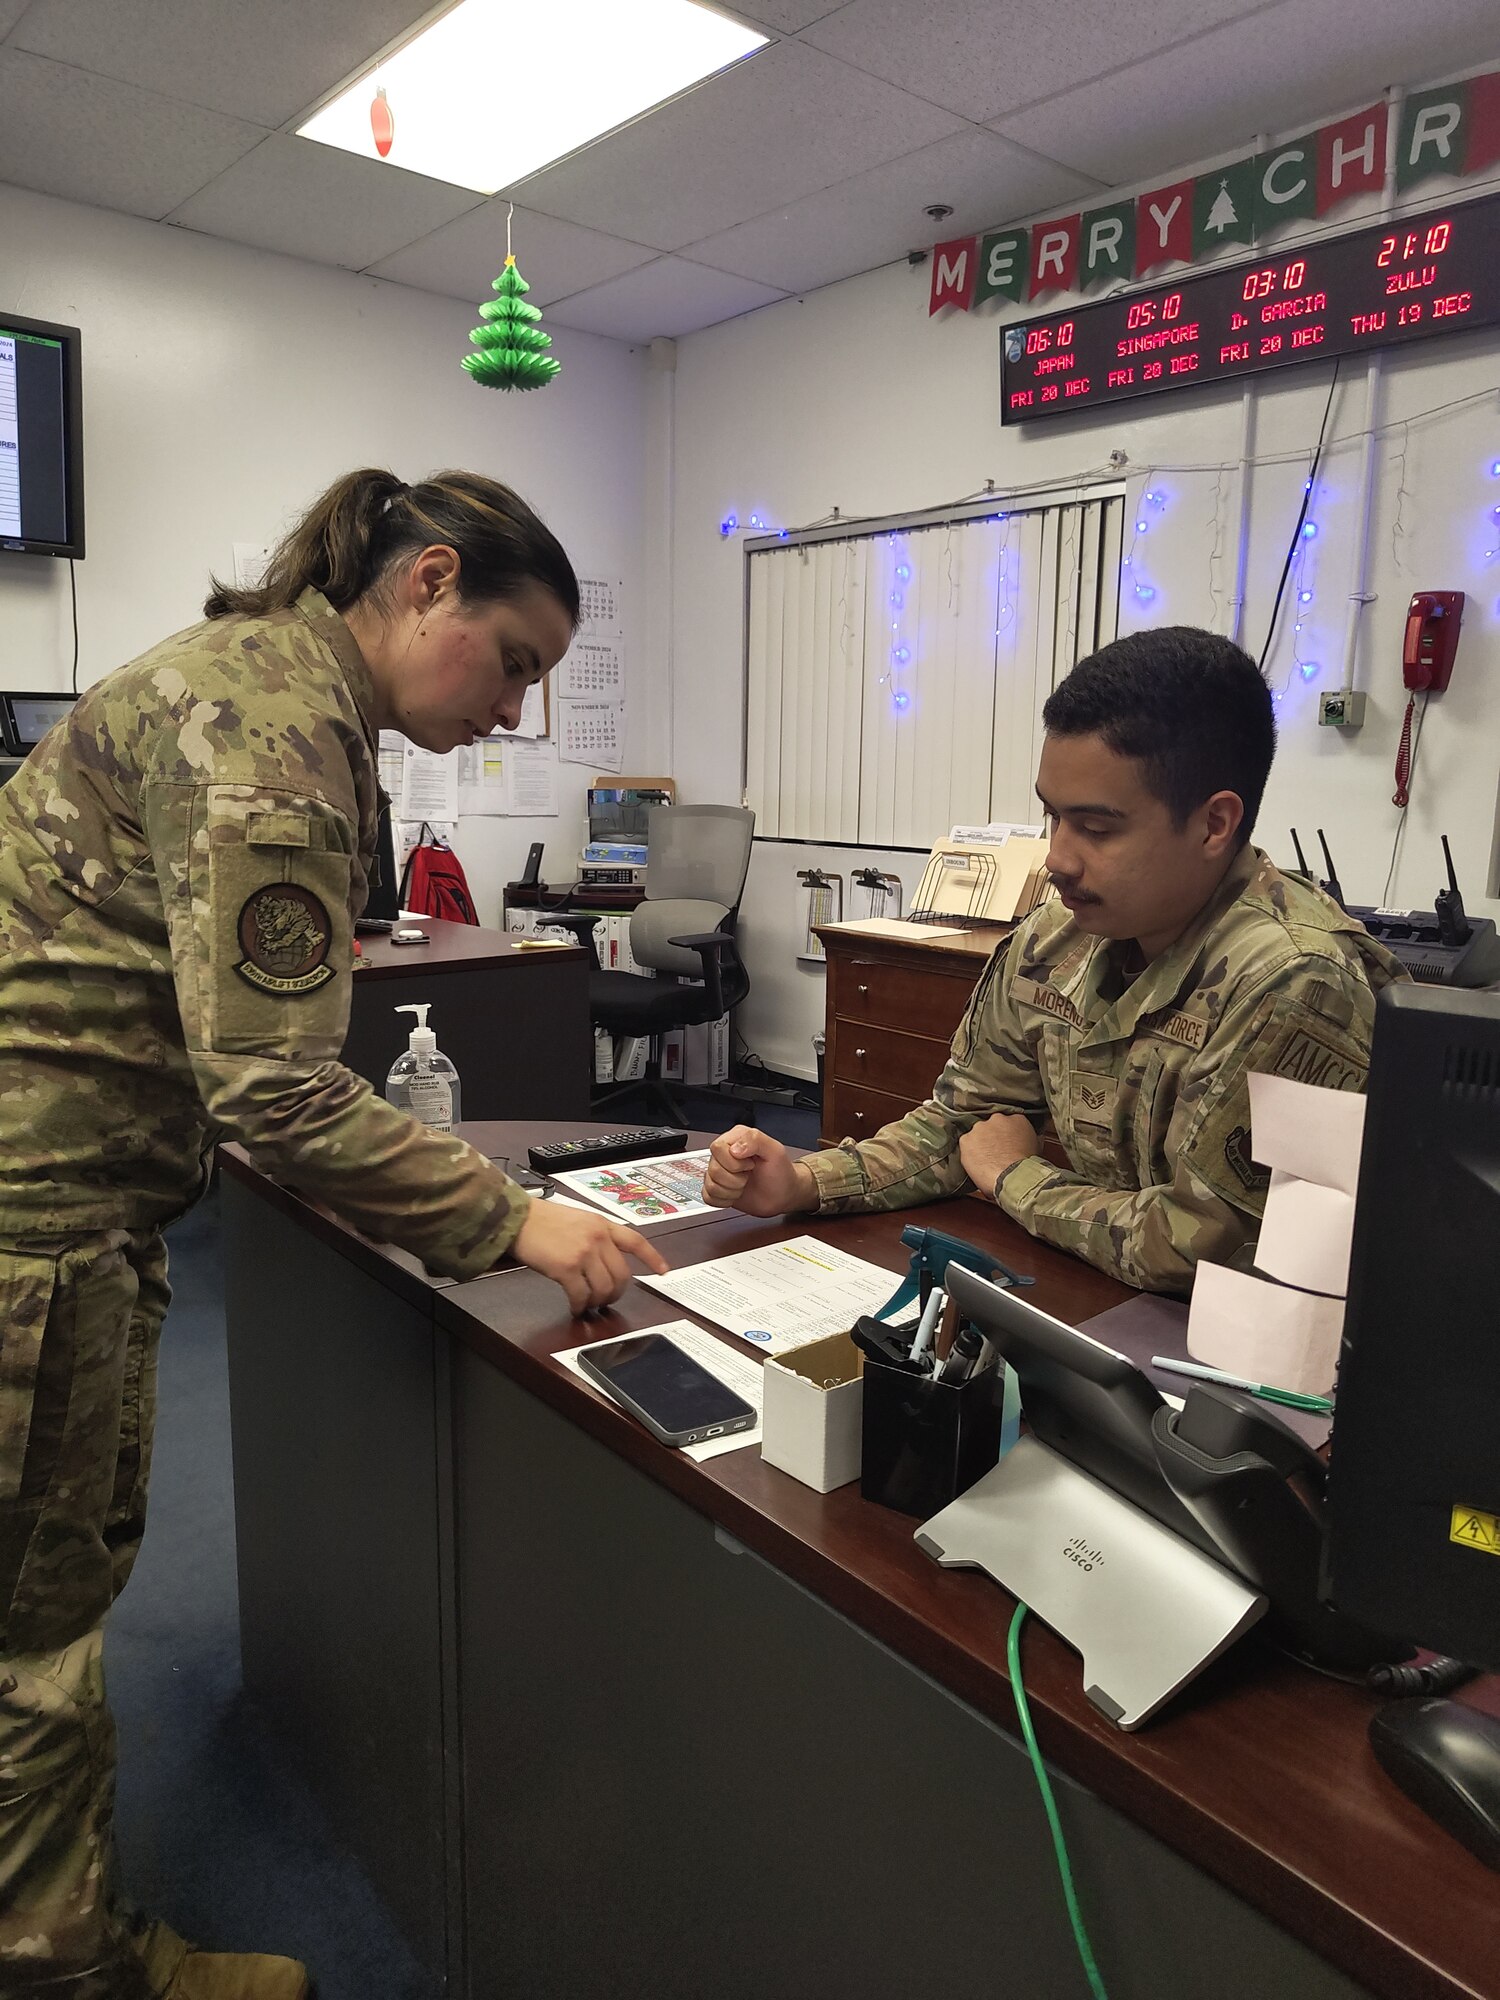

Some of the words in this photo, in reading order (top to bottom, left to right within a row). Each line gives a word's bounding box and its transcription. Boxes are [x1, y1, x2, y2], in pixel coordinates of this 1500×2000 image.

[935, 194, 1183, 296] MERRY
[1262, 102, 1462, 205] CHR
[1376, 222, 1451, 268] 21:10
[1242, 260, 1306, 301] 03:10
[1385, 265, 1436, 295] ZULU
[1127, 294, 1182, 330] 05:10
[1230, 312, 1249, 331] D.
[1261, 292, 1327, 324] GARCIA
[1350, 311, 1387, 336] THU
[1397, 304, 1422, 326] 19
[1432, 292, 1473, 319] DEC
[1026, 322, 1075, 355] 06:10
[1116, 323, 1200, 357] SINGAPORE
[1219, 342, 1250, 365] FRI
[1260, 336, 1282, 355] 20
[1291, 325, 1325, 349] DEC
[1033, 353, 1075, 376] JAPAN
[1107, 368, 1134, 388] FRI
[1143, 361, 1163, 380] 20
[1169, 353, 1199, 374] DEC
[1010, 391, 1034, 409] FRI
[1041, 384, 1058, 402] 20
[1064, 377, 1091, 397] DEC
[1164, 1014, 1203, 1045] FORCE
[1062, 1547, 1093, 1572] CISCO
